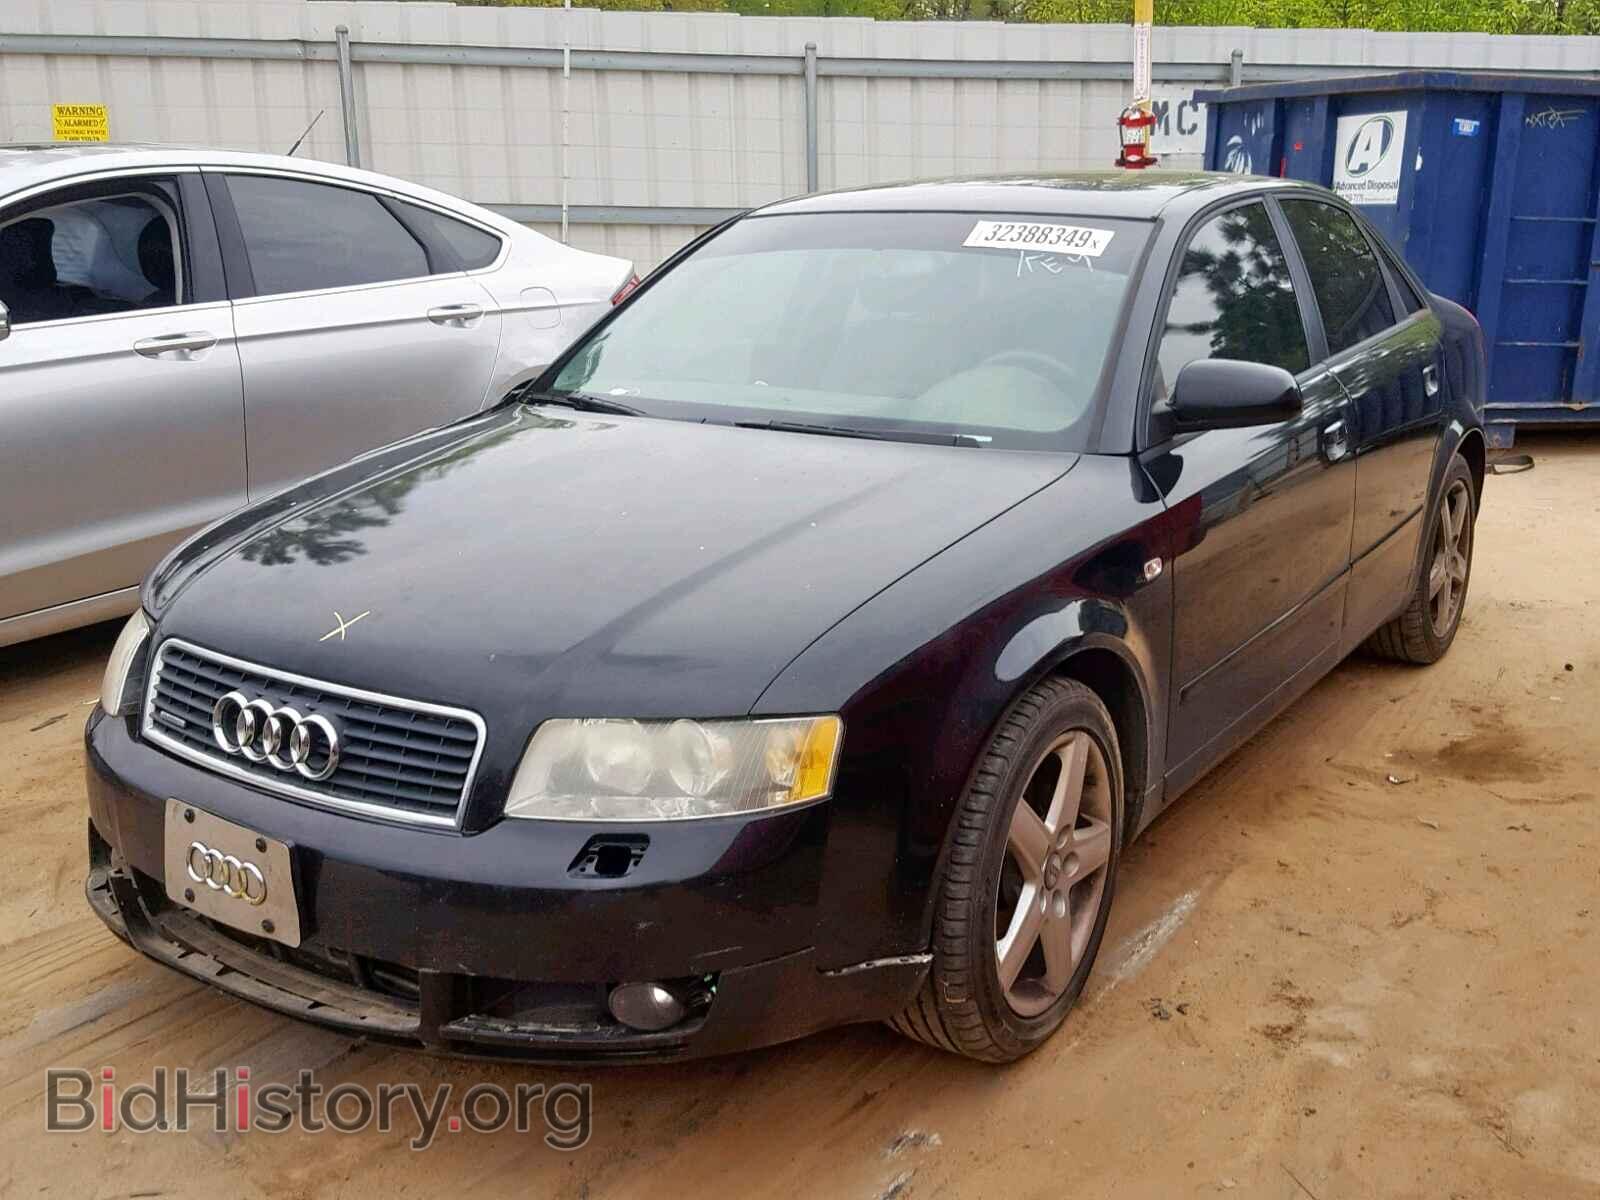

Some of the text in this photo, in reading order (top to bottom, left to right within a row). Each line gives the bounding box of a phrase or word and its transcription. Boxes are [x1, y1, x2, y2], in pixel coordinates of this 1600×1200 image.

[57, 106, 103, 115] WARNING
[64, 119, 99, 127] ALARMED
[1336, 179, 1398, 192] Advanced Disposal
[984, 223, 1092, 248] 32388349
